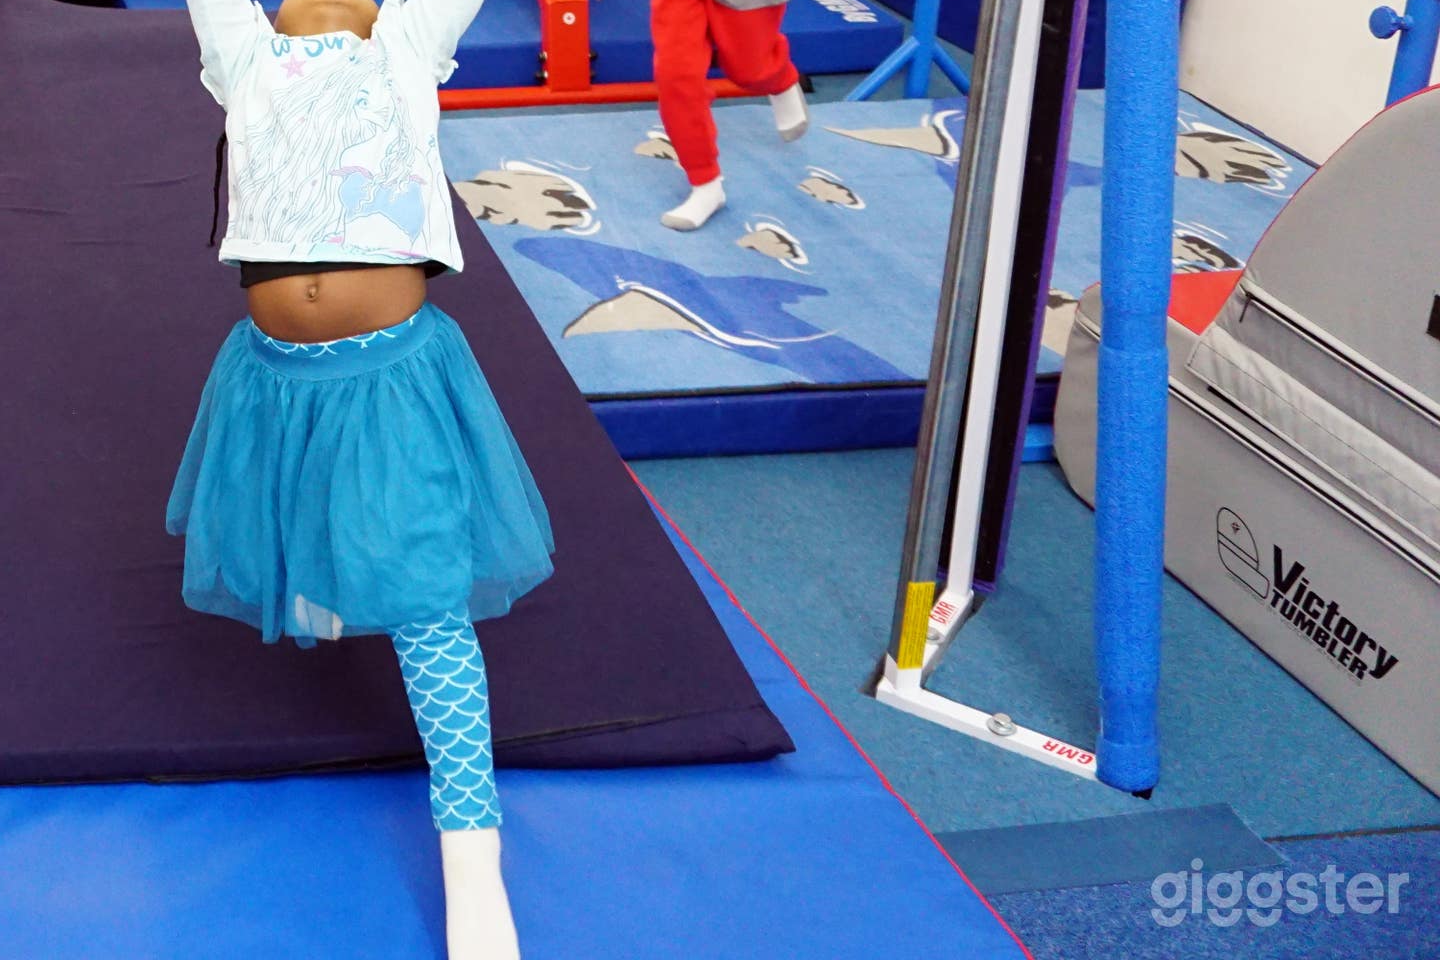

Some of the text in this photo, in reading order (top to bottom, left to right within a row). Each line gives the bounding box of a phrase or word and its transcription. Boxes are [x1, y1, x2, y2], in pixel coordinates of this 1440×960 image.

[928, 600, 957, 626] GMR
[1270, 588, 1369, 681] TUMBLER
[1272, 544, 1400, 680] Victory
[1042, 740, 1095, 765] GMR
